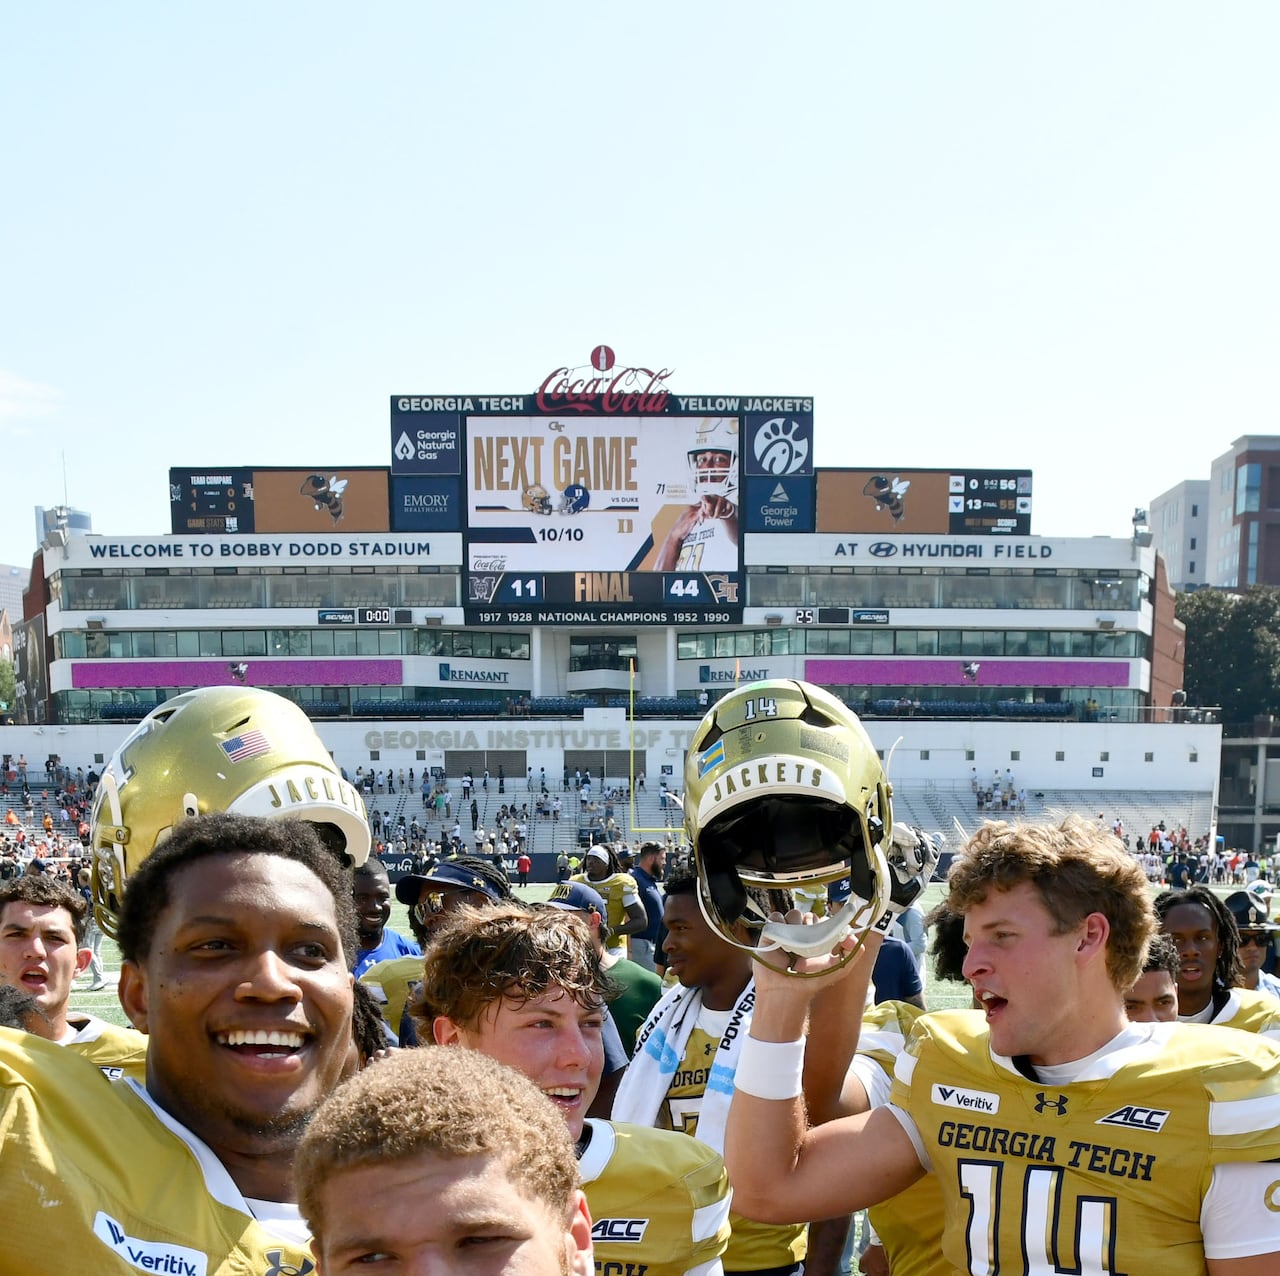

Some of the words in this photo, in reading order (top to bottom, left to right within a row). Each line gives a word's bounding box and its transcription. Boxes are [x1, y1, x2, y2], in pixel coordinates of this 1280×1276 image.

[397, 397, 475, 412] GEORGIA
[478, 396, 524, 412] TECH
[678, 397, 740, 412] YELLOW
[743, 398, 813, 413] JACKETS
[416, 430, 457, 442] Georgia
[417, 440, 456, 451] Natural
[417, 450, 439, 461] Gas
[474, 436, 544, 491] NEXT
[553, 436, 638, 491] GAME
[999, 479, 1017, 490] 56
[404, 495, 449, 507] EMORY
[966, 499, 982, 510] 13
[761, 506, 798, 519] Georgia
[764, 516, 794, 527] Power
[539, 527, 584, 543] 10/10
[90, 544, 184, 558] WELCOME
[189, 544, 214, 557] TO
[220, 543, 283, 557] BOBBY
[288, 543, 342, 556] DODD
[349, 542, 431, 556] STADIUM
[834, 543, 858, 557] AT
[903, 545, 983, 558] HYUNDAI
[995, 545, 1052, 559] FIELD
[510, 579, 537, 597] 11
[574, 572, 633, 602] FINAL
[670, 579, 699, 597] 44
[365, 610, 390, 623] 0:00
[478, 612, 502, 623] 1917
[507, 612, 533, 623] 1928
[538, 612, 598, 623] NATIONAL
[600, 612, 667, 623] CHAMPIONS
[673, 612, 699, 623] 1952
[703, 612, 730, 623] 1990
[795, 610, 813, 624] 25
[450, 670, 510, 684] RENASANT
[744, 696, 778, 720] 14
[364, 730, 481, 750] GEORGIA
[486, 729, 629, 749] INSTITUTE
[634, 729, 663, 749] OF
[714, 762, 822, 802] JACKETS
[955, 1092, 994, 1113] Veritiv
[1108, 1105, 1169, 1131] ACC
[937, 1121, 1057, 1163] GEORGIA
[1067, 1140, 1157, 1181] TECH
[592, 1219, 646, 1241] ACC
